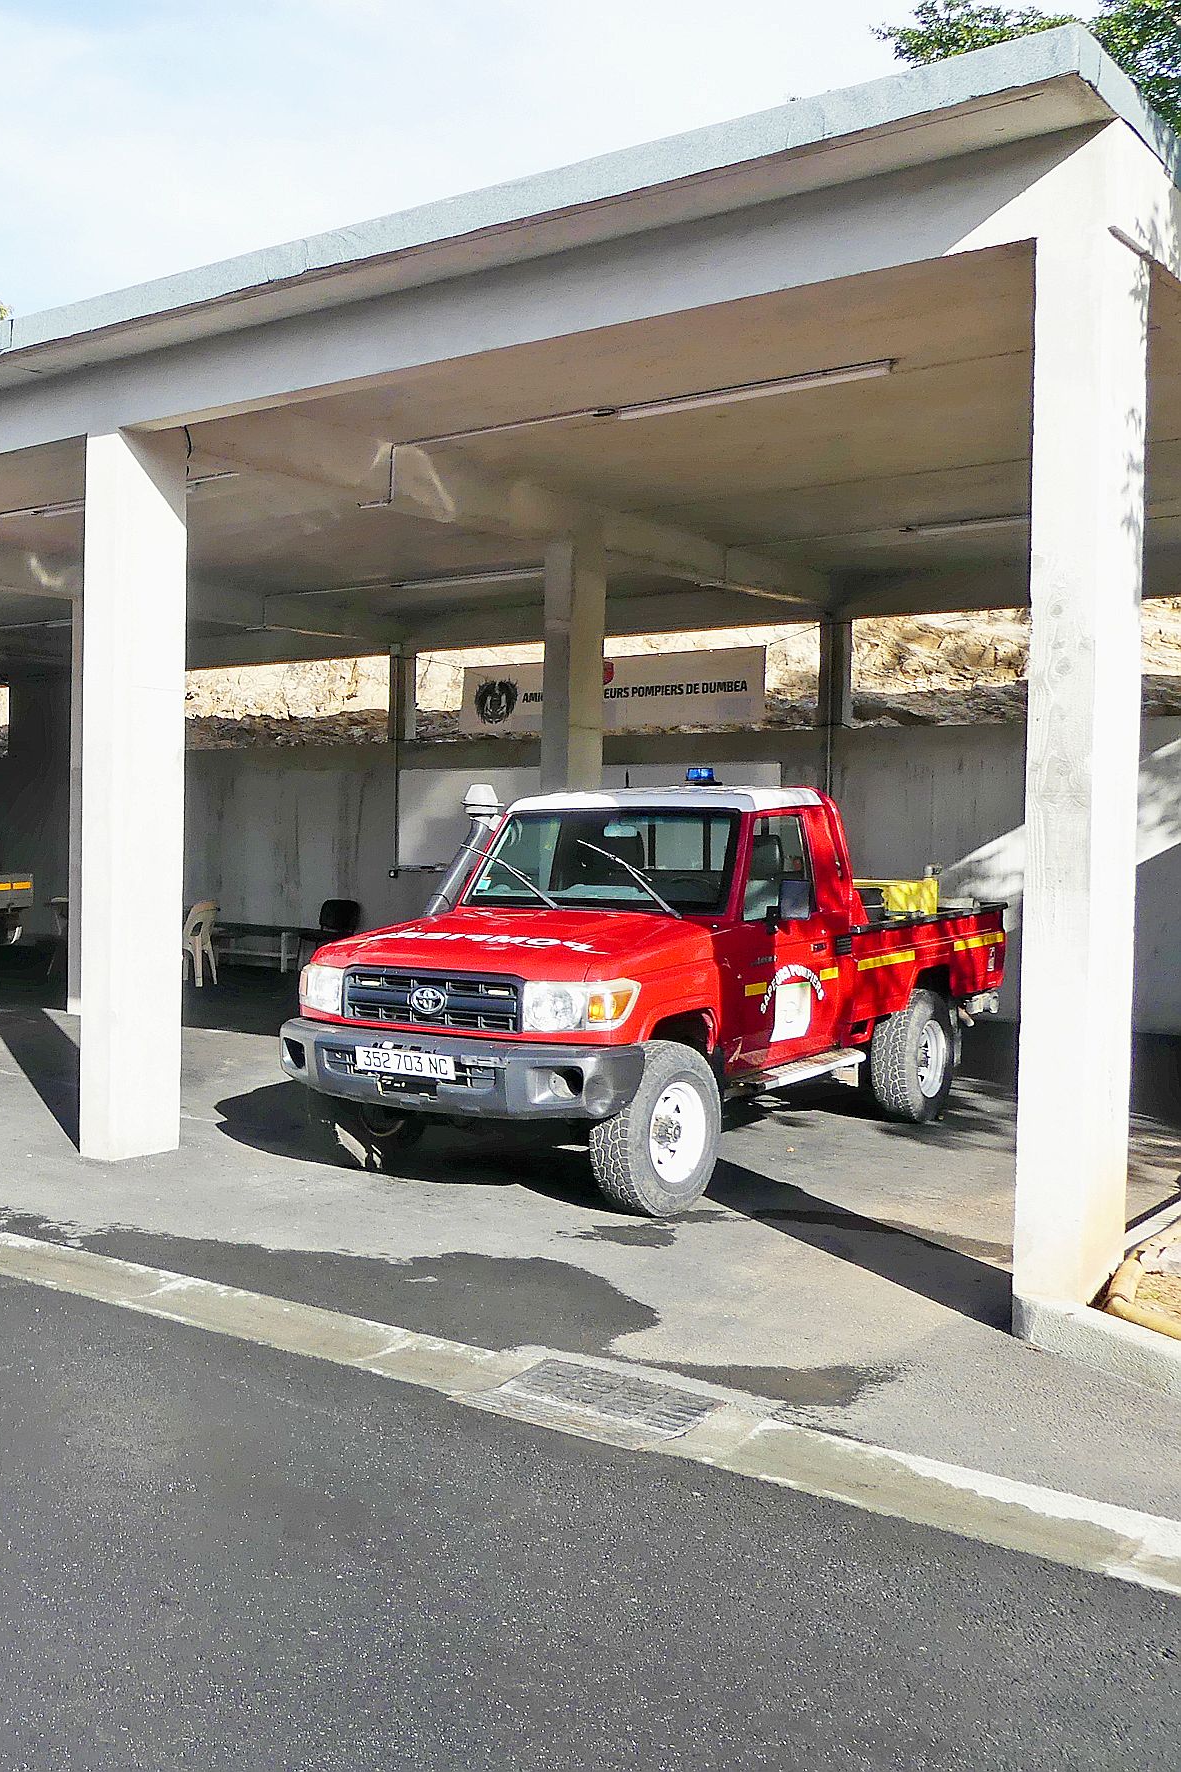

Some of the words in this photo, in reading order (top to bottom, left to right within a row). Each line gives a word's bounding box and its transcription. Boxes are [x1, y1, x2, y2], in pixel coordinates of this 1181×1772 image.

[604, 687, 630, 699] EURS
[631, 683, 684, 698] POMPIERS
[686, 682, 700, 695] DE
[702, 680, 748, 694] DUMBEA
[760, 965, 790, 1014] SAPEURS
[788, 964, 825, 1001] POMPIERS
[363, 1050, 392, 1069] 352
[394, 1053, 423, 1072] 703
[429, 1057, 448, 1075] NC
